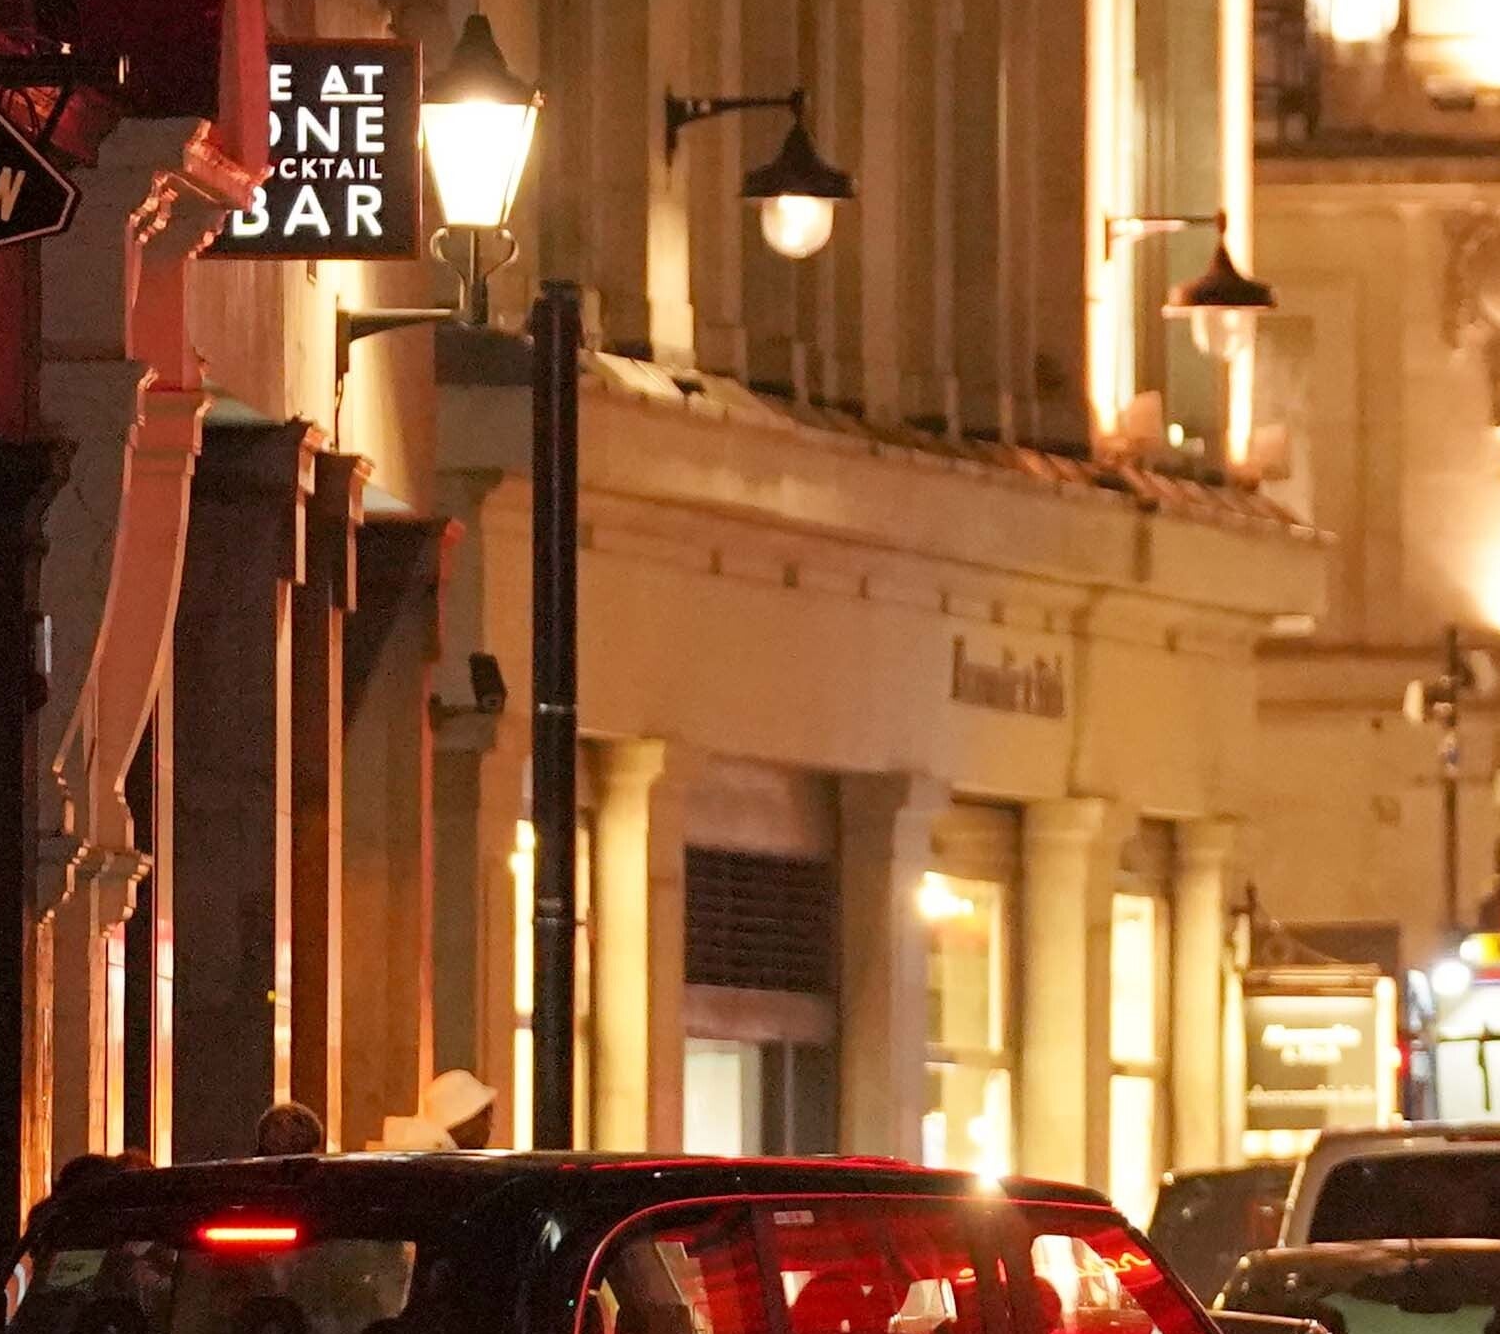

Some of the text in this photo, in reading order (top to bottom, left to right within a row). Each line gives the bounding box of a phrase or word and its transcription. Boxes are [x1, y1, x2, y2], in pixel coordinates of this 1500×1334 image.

[320, 64, 384, 102] AT
[269, 157, 384, 181] CKTAIL
[232, 184, 384, 238] BAR
